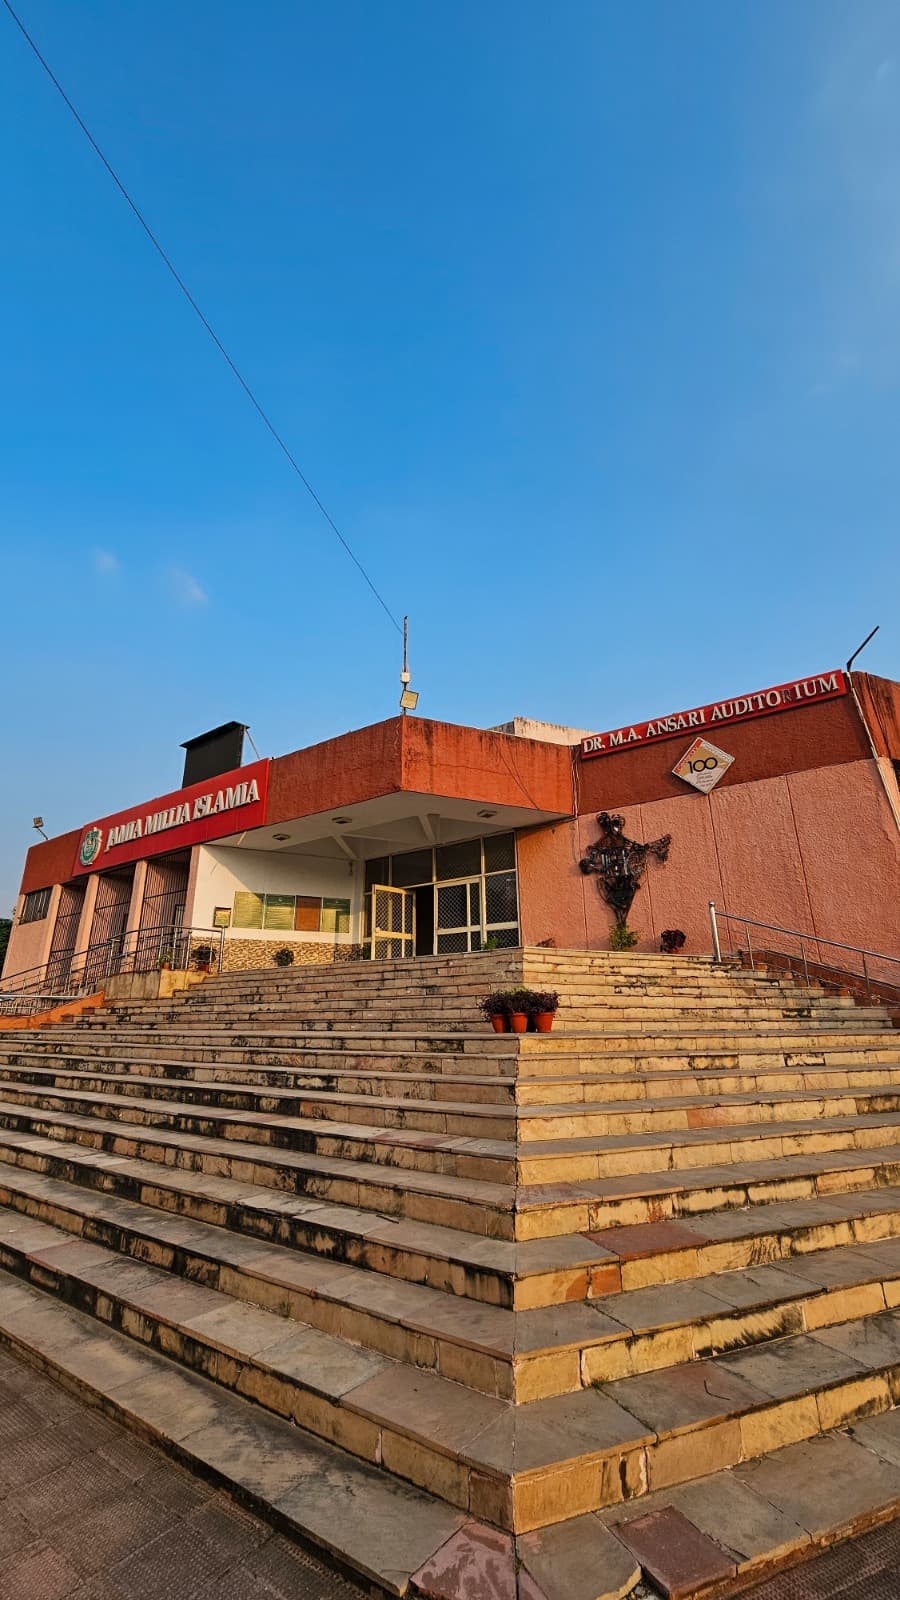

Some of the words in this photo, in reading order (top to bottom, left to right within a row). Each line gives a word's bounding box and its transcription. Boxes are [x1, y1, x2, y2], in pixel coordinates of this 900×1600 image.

[583, 736, 606, 753] DR.
[609, 727, 642, 747] M.A.
[646, 709, 706, 738] ANSARI
[711, 674, 839, 721] AUDITORIUM
[688, 757, 718, 774] 100
[104, 819, 142, 852] JAMIA
[144, 802, 190, 836] MILLIA
[192, 779, 260, 821] ISLAMIA
